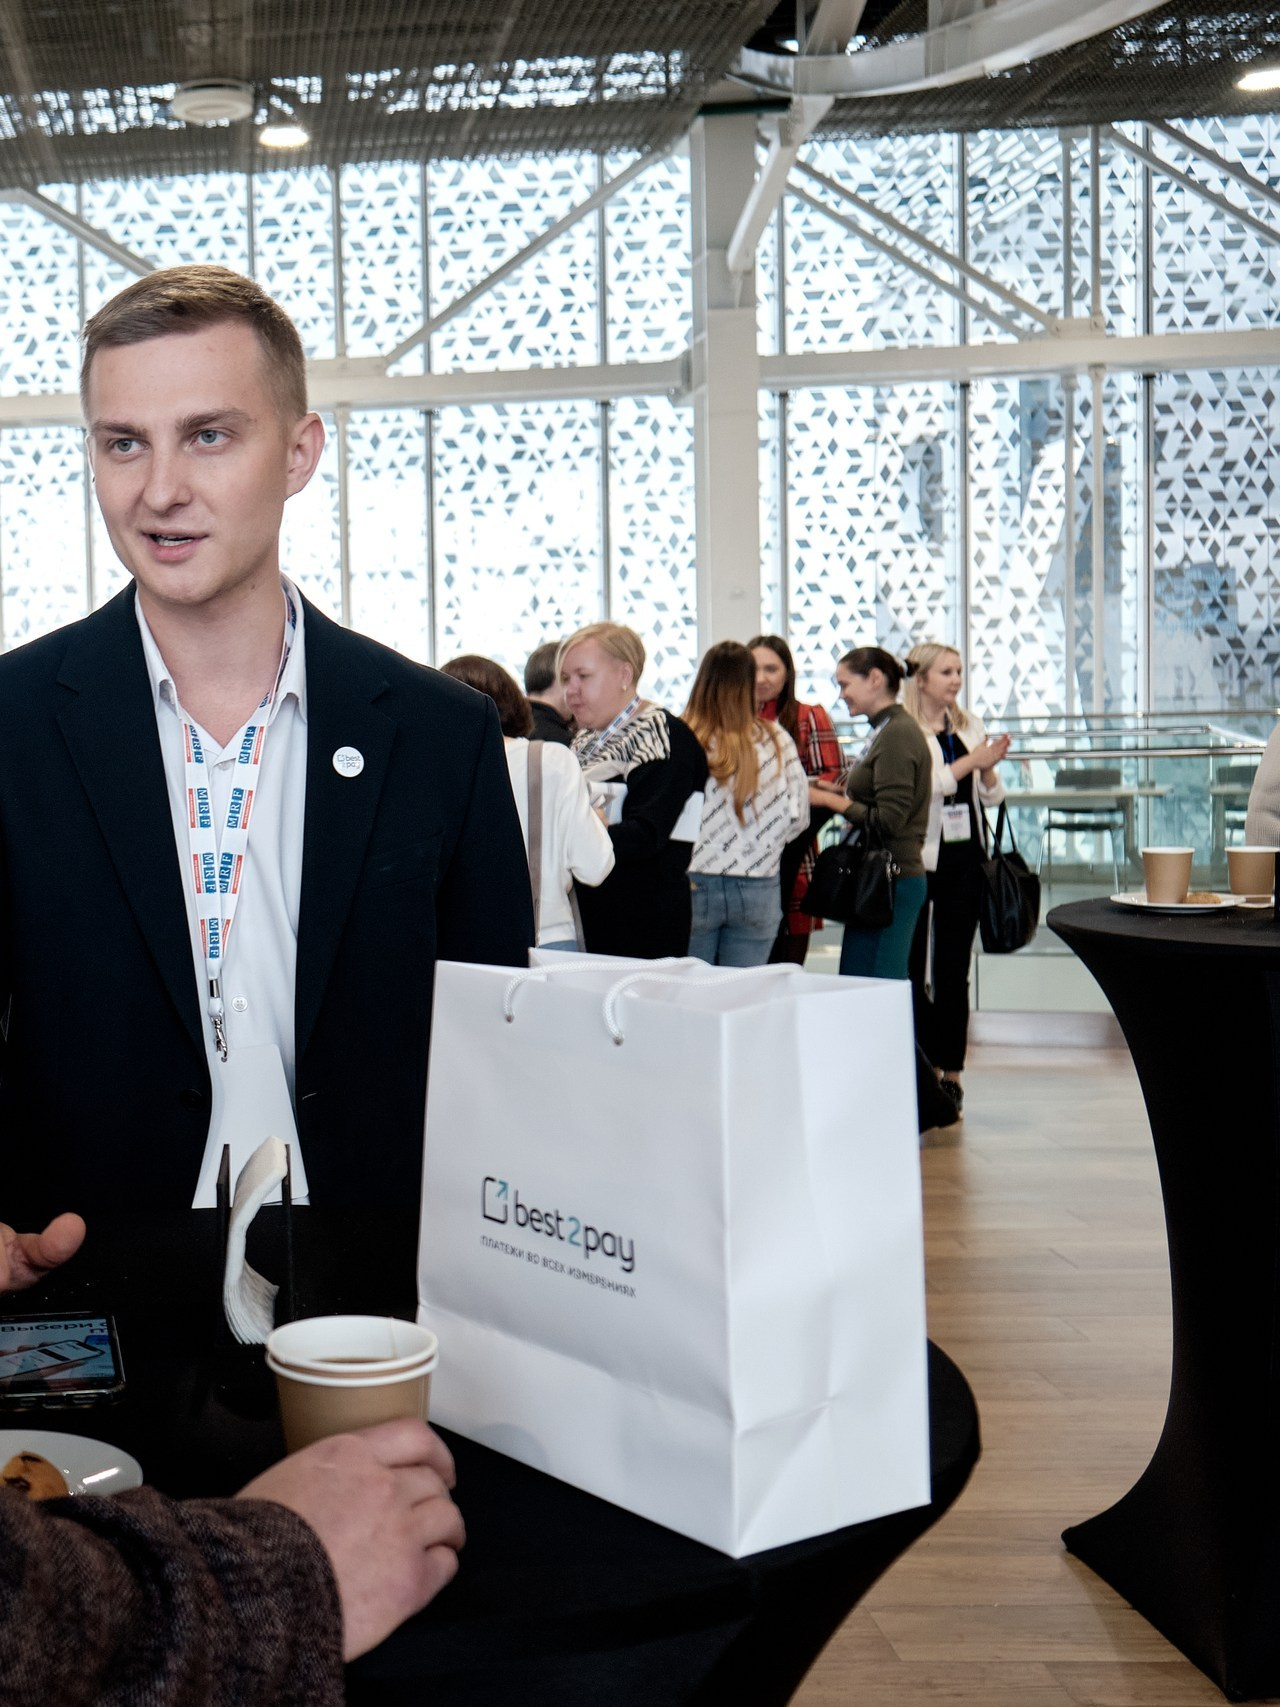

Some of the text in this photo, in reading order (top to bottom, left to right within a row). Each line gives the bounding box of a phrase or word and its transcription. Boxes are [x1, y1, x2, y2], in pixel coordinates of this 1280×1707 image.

[238, 726, 256, 764] MRF
[197, 788, 211, 828] MRF
[227, 788, 244, 828] MRF
[203, 853, 216, 893] MRF
[219, 853, 233, 893] MRF
[209, 918, 219, 958] MRF
[514, 1190, 636, 1273] best2pay
[481, 1235, 637, 1298] ПЛАТЕЖИ ВО ВСЕХ ИЗМЕРЕНИЯХ
[1, 1323, 93, 1333] Выбери
